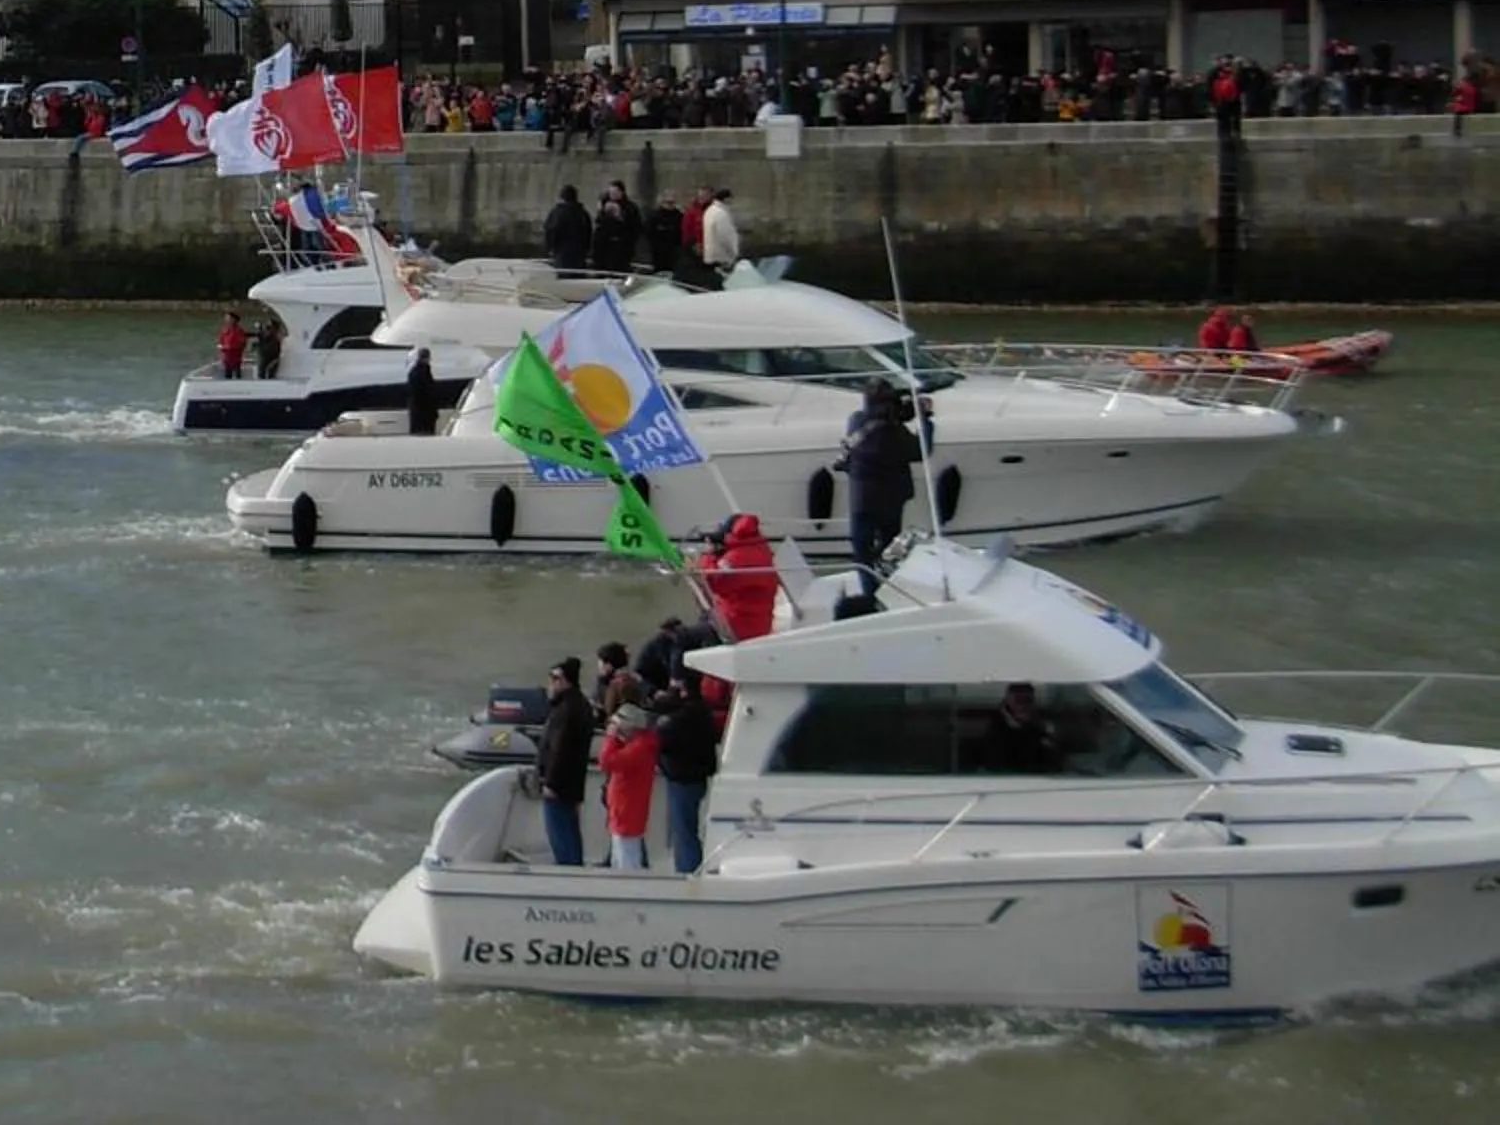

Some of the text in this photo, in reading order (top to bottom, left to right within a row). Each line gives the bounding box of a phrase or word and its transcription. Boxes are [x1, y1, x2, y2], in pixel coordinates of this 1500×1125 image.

[369, 474, 385, 488] AY
[462, 936, 781, 972] les Sables d'Olonne
